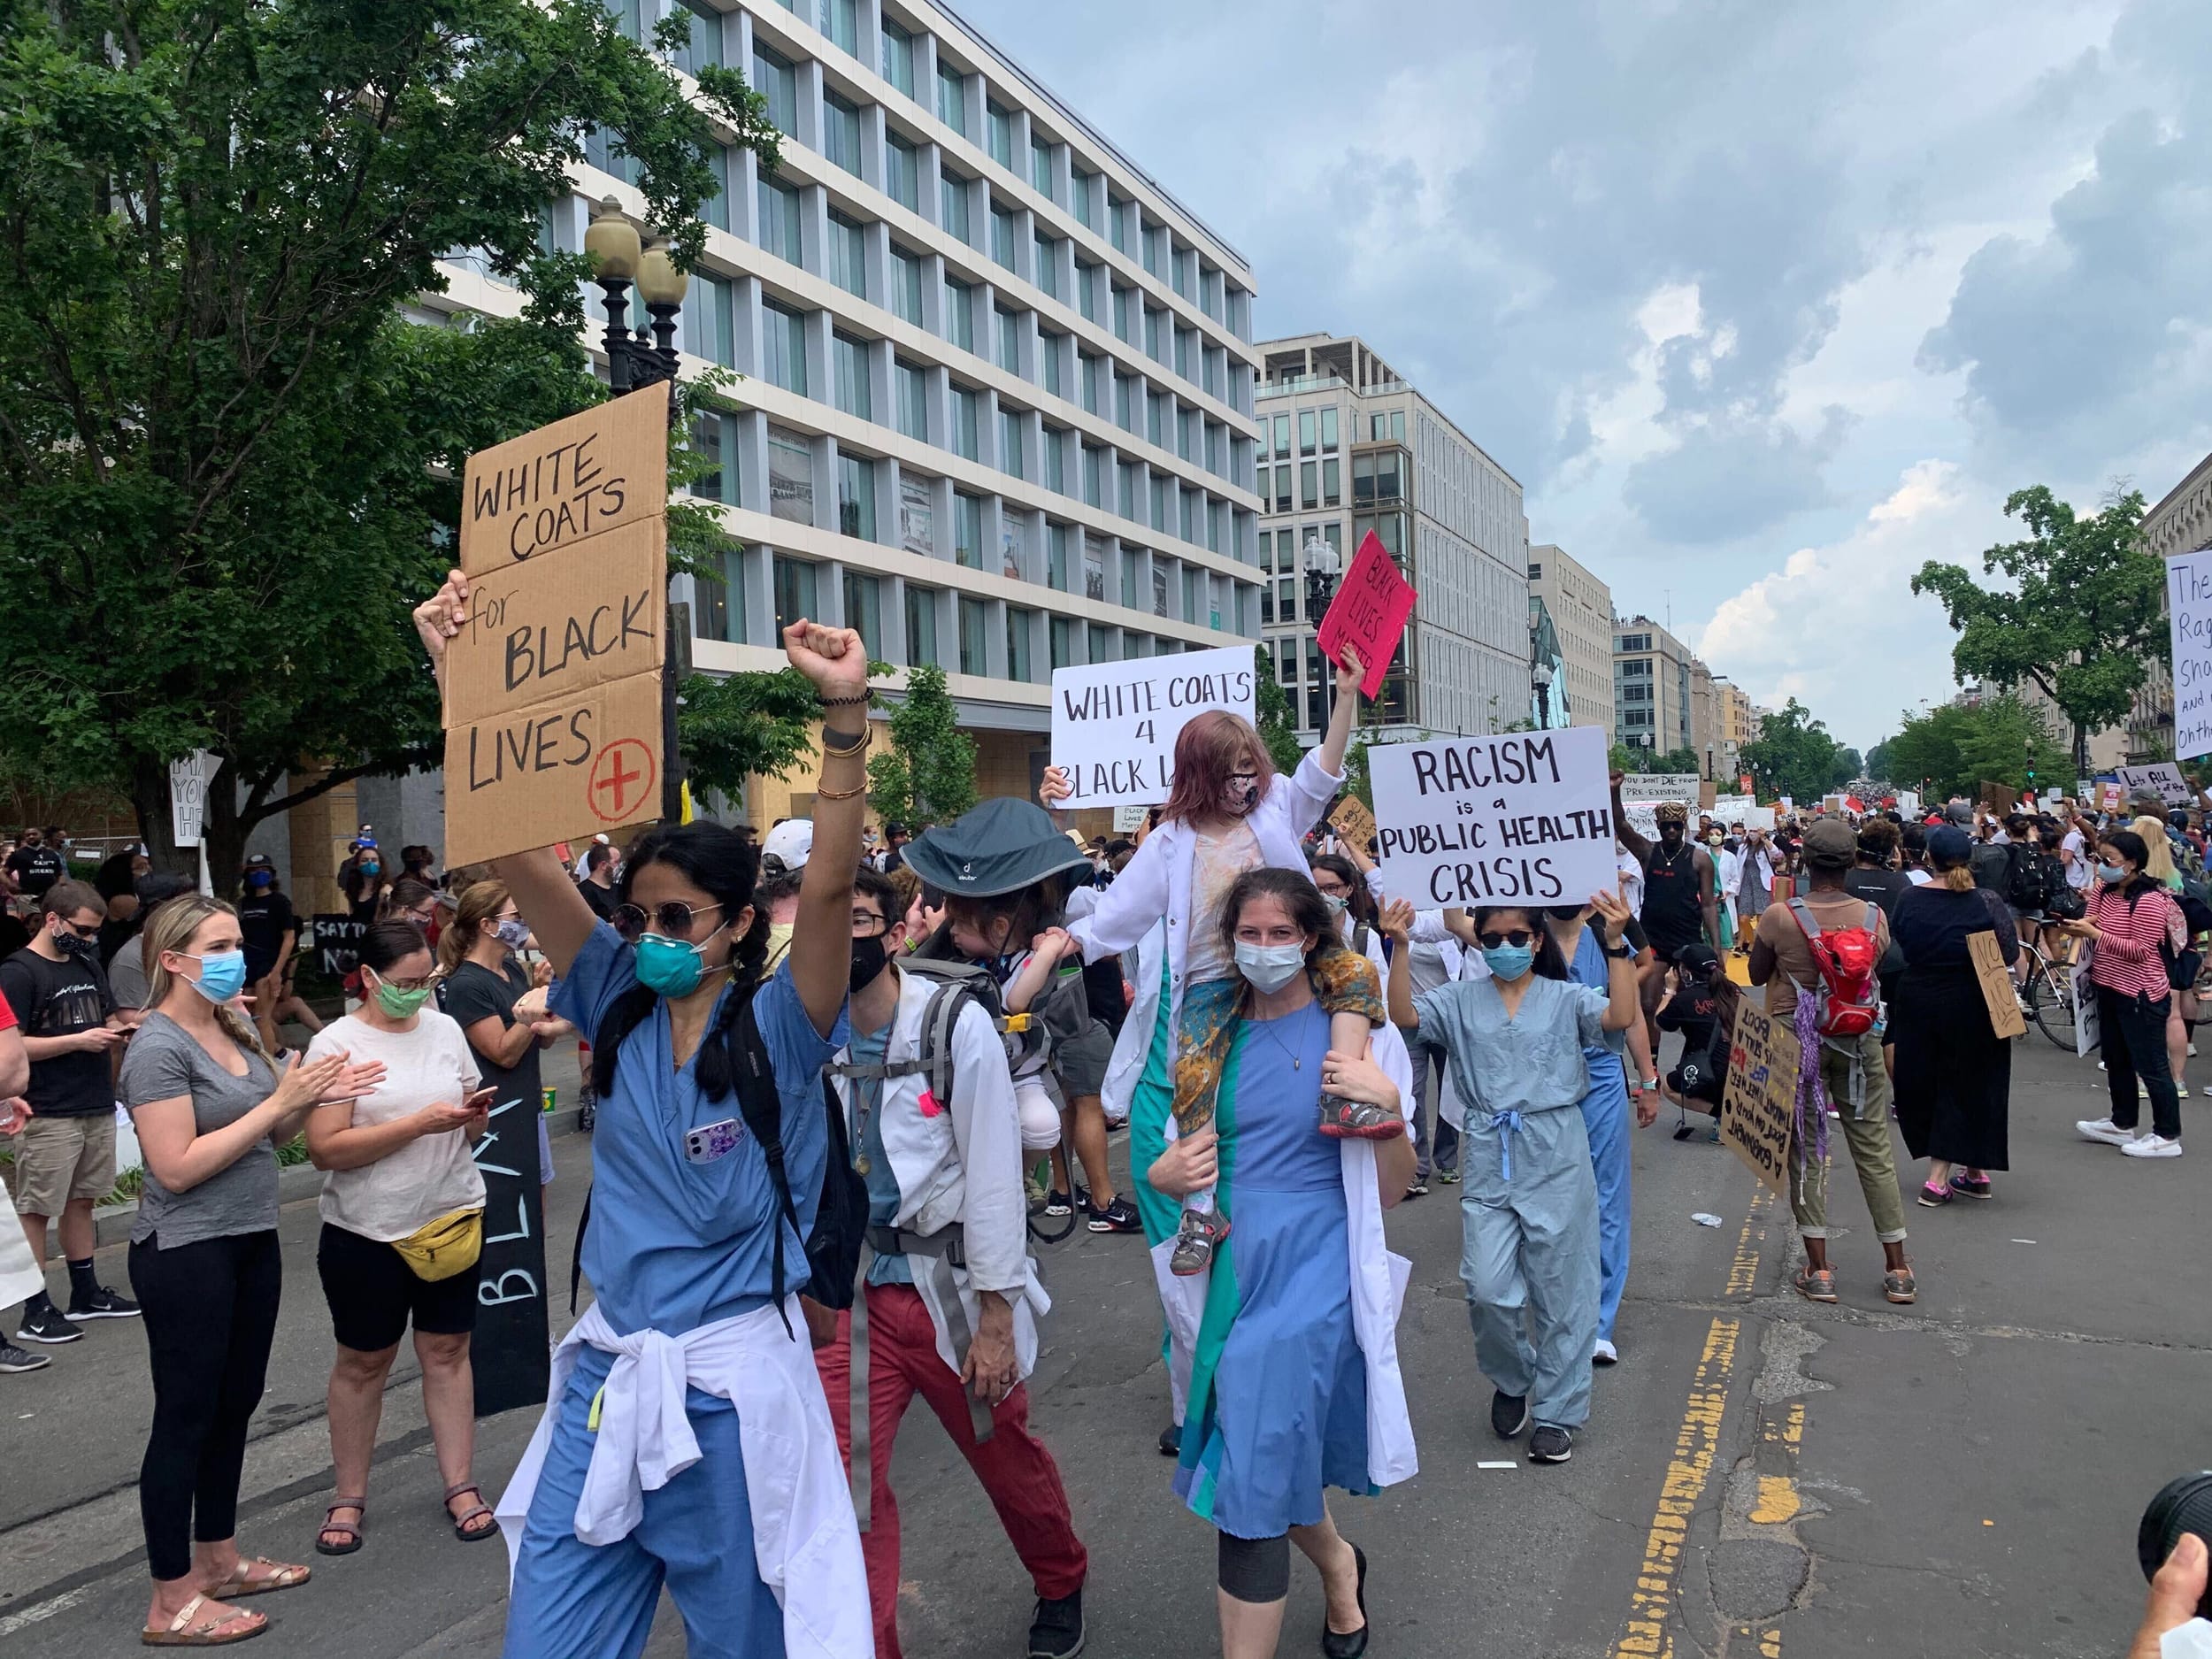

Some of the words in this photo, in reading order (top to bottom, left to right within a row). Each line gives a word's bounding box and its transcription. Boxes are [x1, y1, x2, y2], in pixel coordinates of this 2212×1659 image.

[473, 433, 602, 522] WHITE
[511, 477, 626, 561] COATS
[1366, 555, 1398, 608] BLACK
[2171, 565, 2212, 603] The
[465, 588, 519, 645] for
[1348, 590, 1383, 643] LIVES
[505, 590, 656, 693] BLACK
[1064, 680, 1162, 722] WHITE
[1169, 672, 1251, 708] COATS
[1135, 719, 1156, 744] 4
[469, 709, 592, 792] LIVES
[1411, 736, 1561, 795] RACISM
[1058, 758, 1149, 799] BLACK
[1626, 787, 1686, 796] PRE-EXISTING
[1661, 776, 1678, 786] DIE
[1740, 780, 1752, 790] 16
[2148, 772, 2170, 784] ALL
[1456, 800, 1473, 815] is
[1493, 798, 1507, 810] a
[1379, 823, 1486, 858] PUBLIC
[1498, 809, 1610, 848] HEALTH
[1430, 856, 1563, 903] CRISIS
[316, 920, 349, 938] SAY
[1977, 935, 2000, 970] NO
[1990, 977, 2012, 1022] NO
[1738, 1027, 1744, 1045] A
[1741, 1007, 1770, 1044] BOOT
[1765, 1048, 1773, 1066] IS
[1735, 1093, 1755, 1126] YOUR
[1763, 1125, 1786, 1154] BOOT
[1774, 1157, 1783, 1179] A
